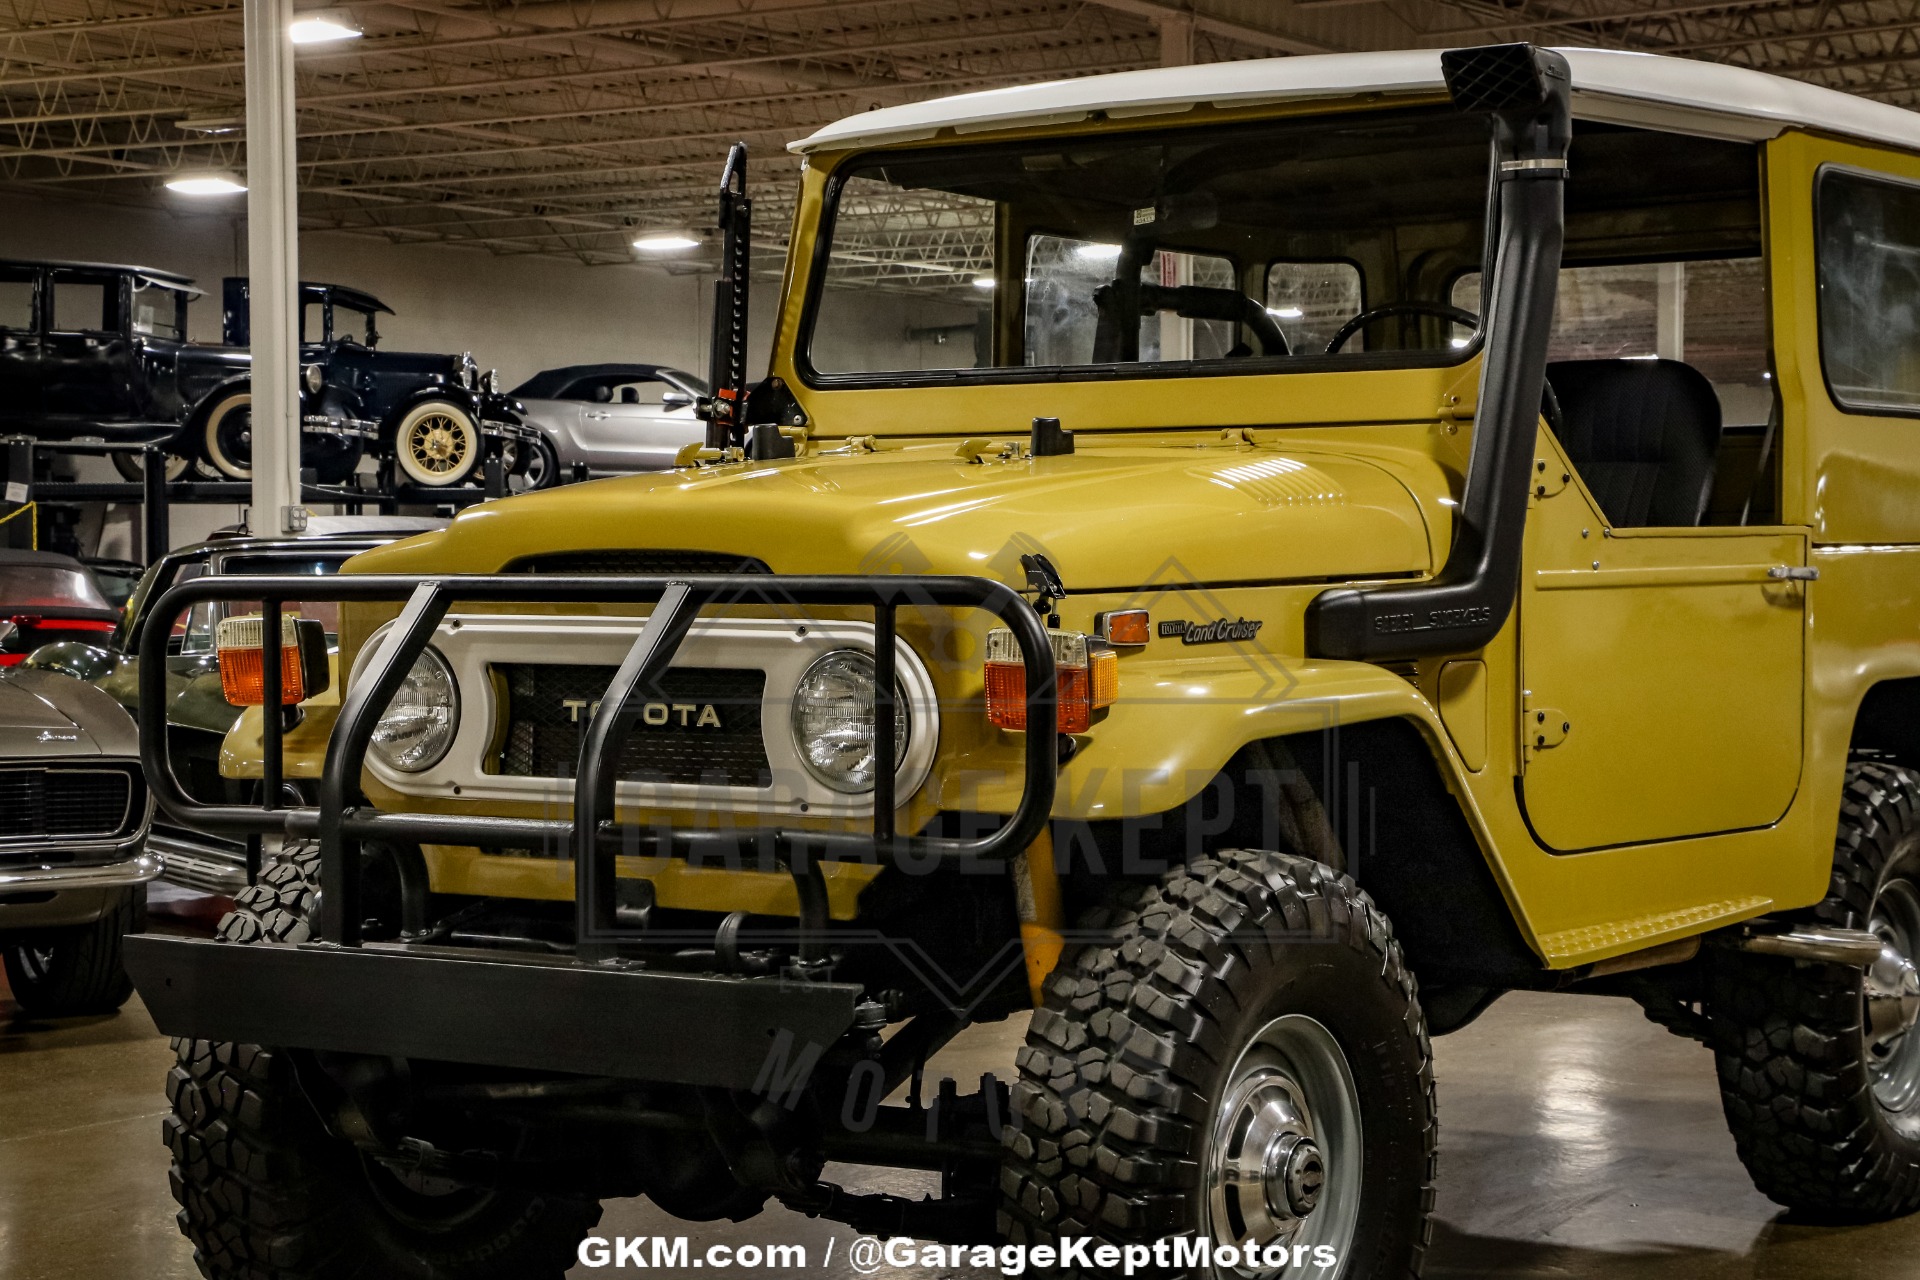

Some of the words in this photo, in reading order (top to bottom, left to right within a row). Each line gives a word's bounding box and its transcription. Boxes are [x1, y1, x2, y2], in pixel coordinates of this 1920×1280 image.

[1185, 622, 1217, 643] Land
[1217, 618, 1262, 640] Cruiser
[562, 699, 722, 728] TOTA
